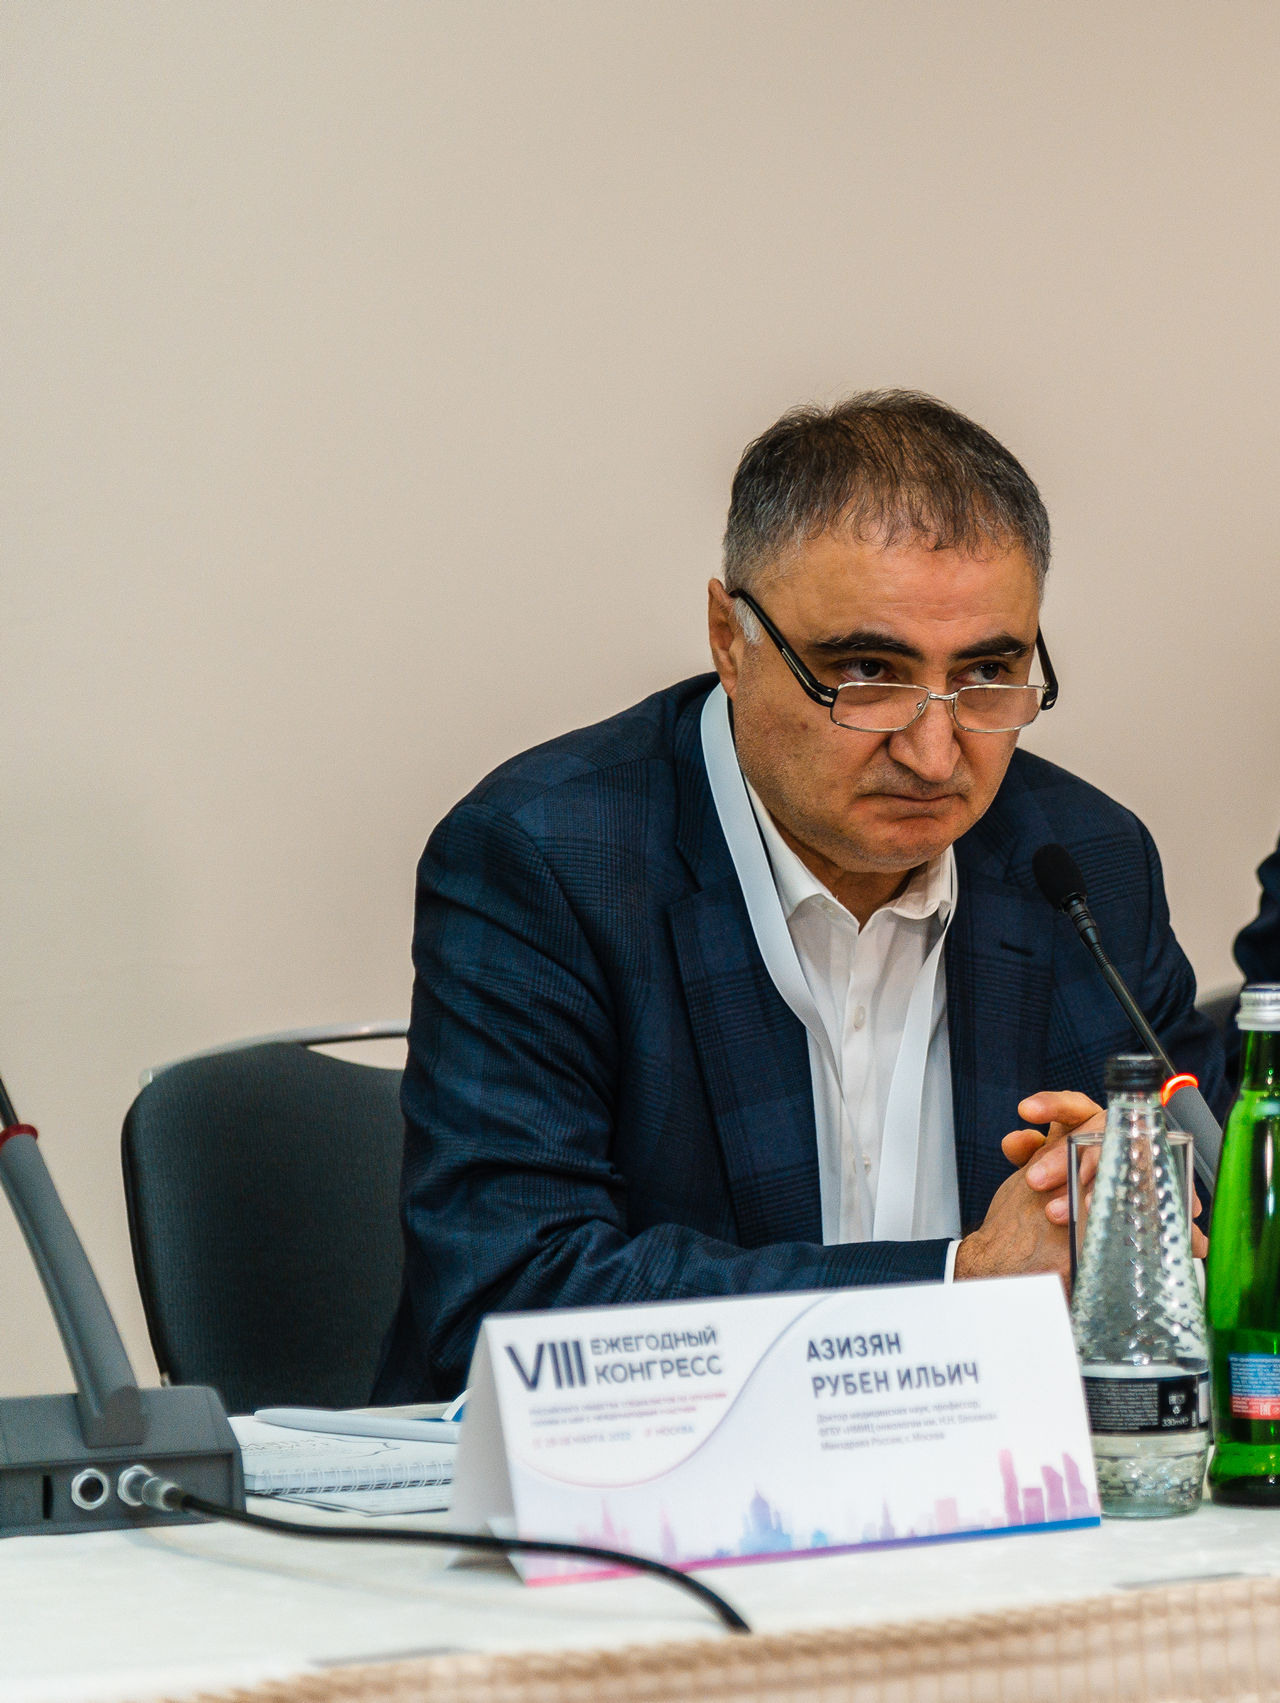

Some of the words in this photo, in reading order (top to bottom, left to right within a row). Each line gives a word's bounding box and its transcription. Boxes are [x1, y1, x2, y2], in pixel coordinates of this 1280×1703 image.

[590, 1326, 718, 1355] ЕЖЕГОДНЫЙ
[807, 1332, 903, 1362] АЗИЗЯН
[504, 1338, 588, 1391] VIII
[594, 1355, 723, 1384] КОНГРЕСС
[811, 1370, 890, 1399] РУБЕН
[896, 1361, 980, 1391] ИЛЬИЧ
